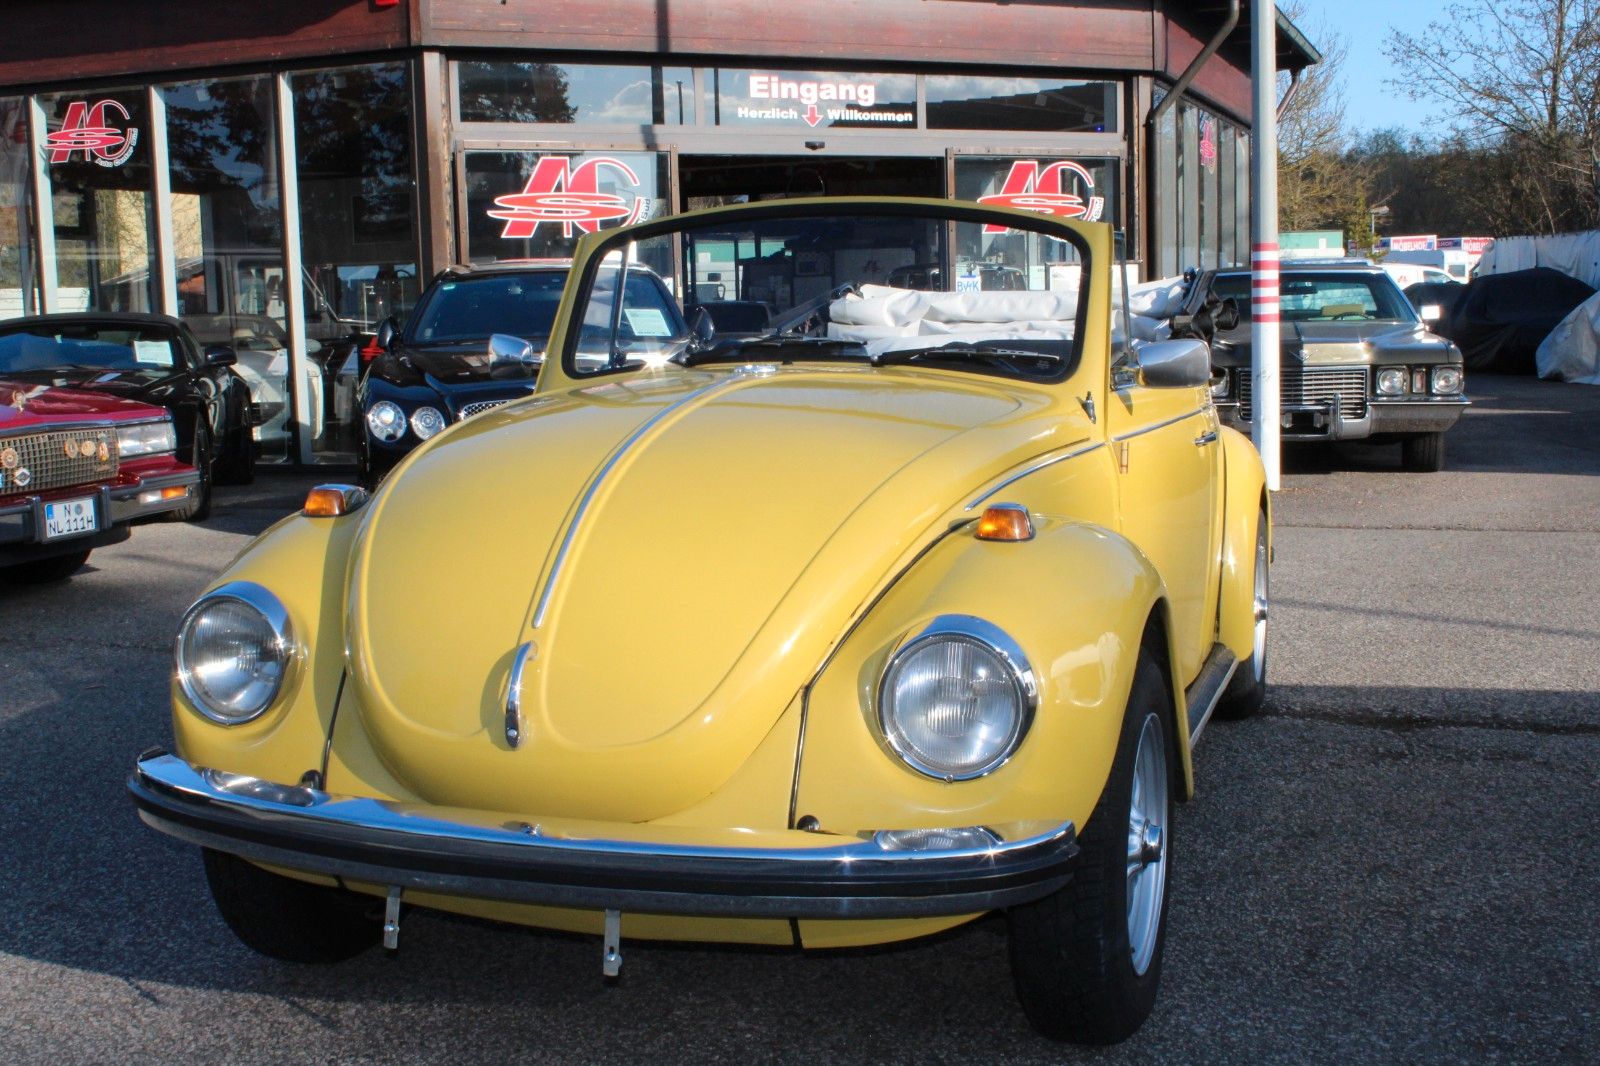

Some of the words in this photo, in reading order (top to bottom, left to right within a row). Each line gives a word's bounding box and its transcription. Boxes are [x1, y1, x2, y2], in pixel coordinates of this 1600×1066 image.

[749, 74, 875, 106] Eingang
[738, 107, 798, 119] Herzlich
[827, 108, 913, 121] Willkommen
[65, 504, 71, 518] N
[49, 521, 63, 535] NL
[66, 516, 93, 531] 111H
